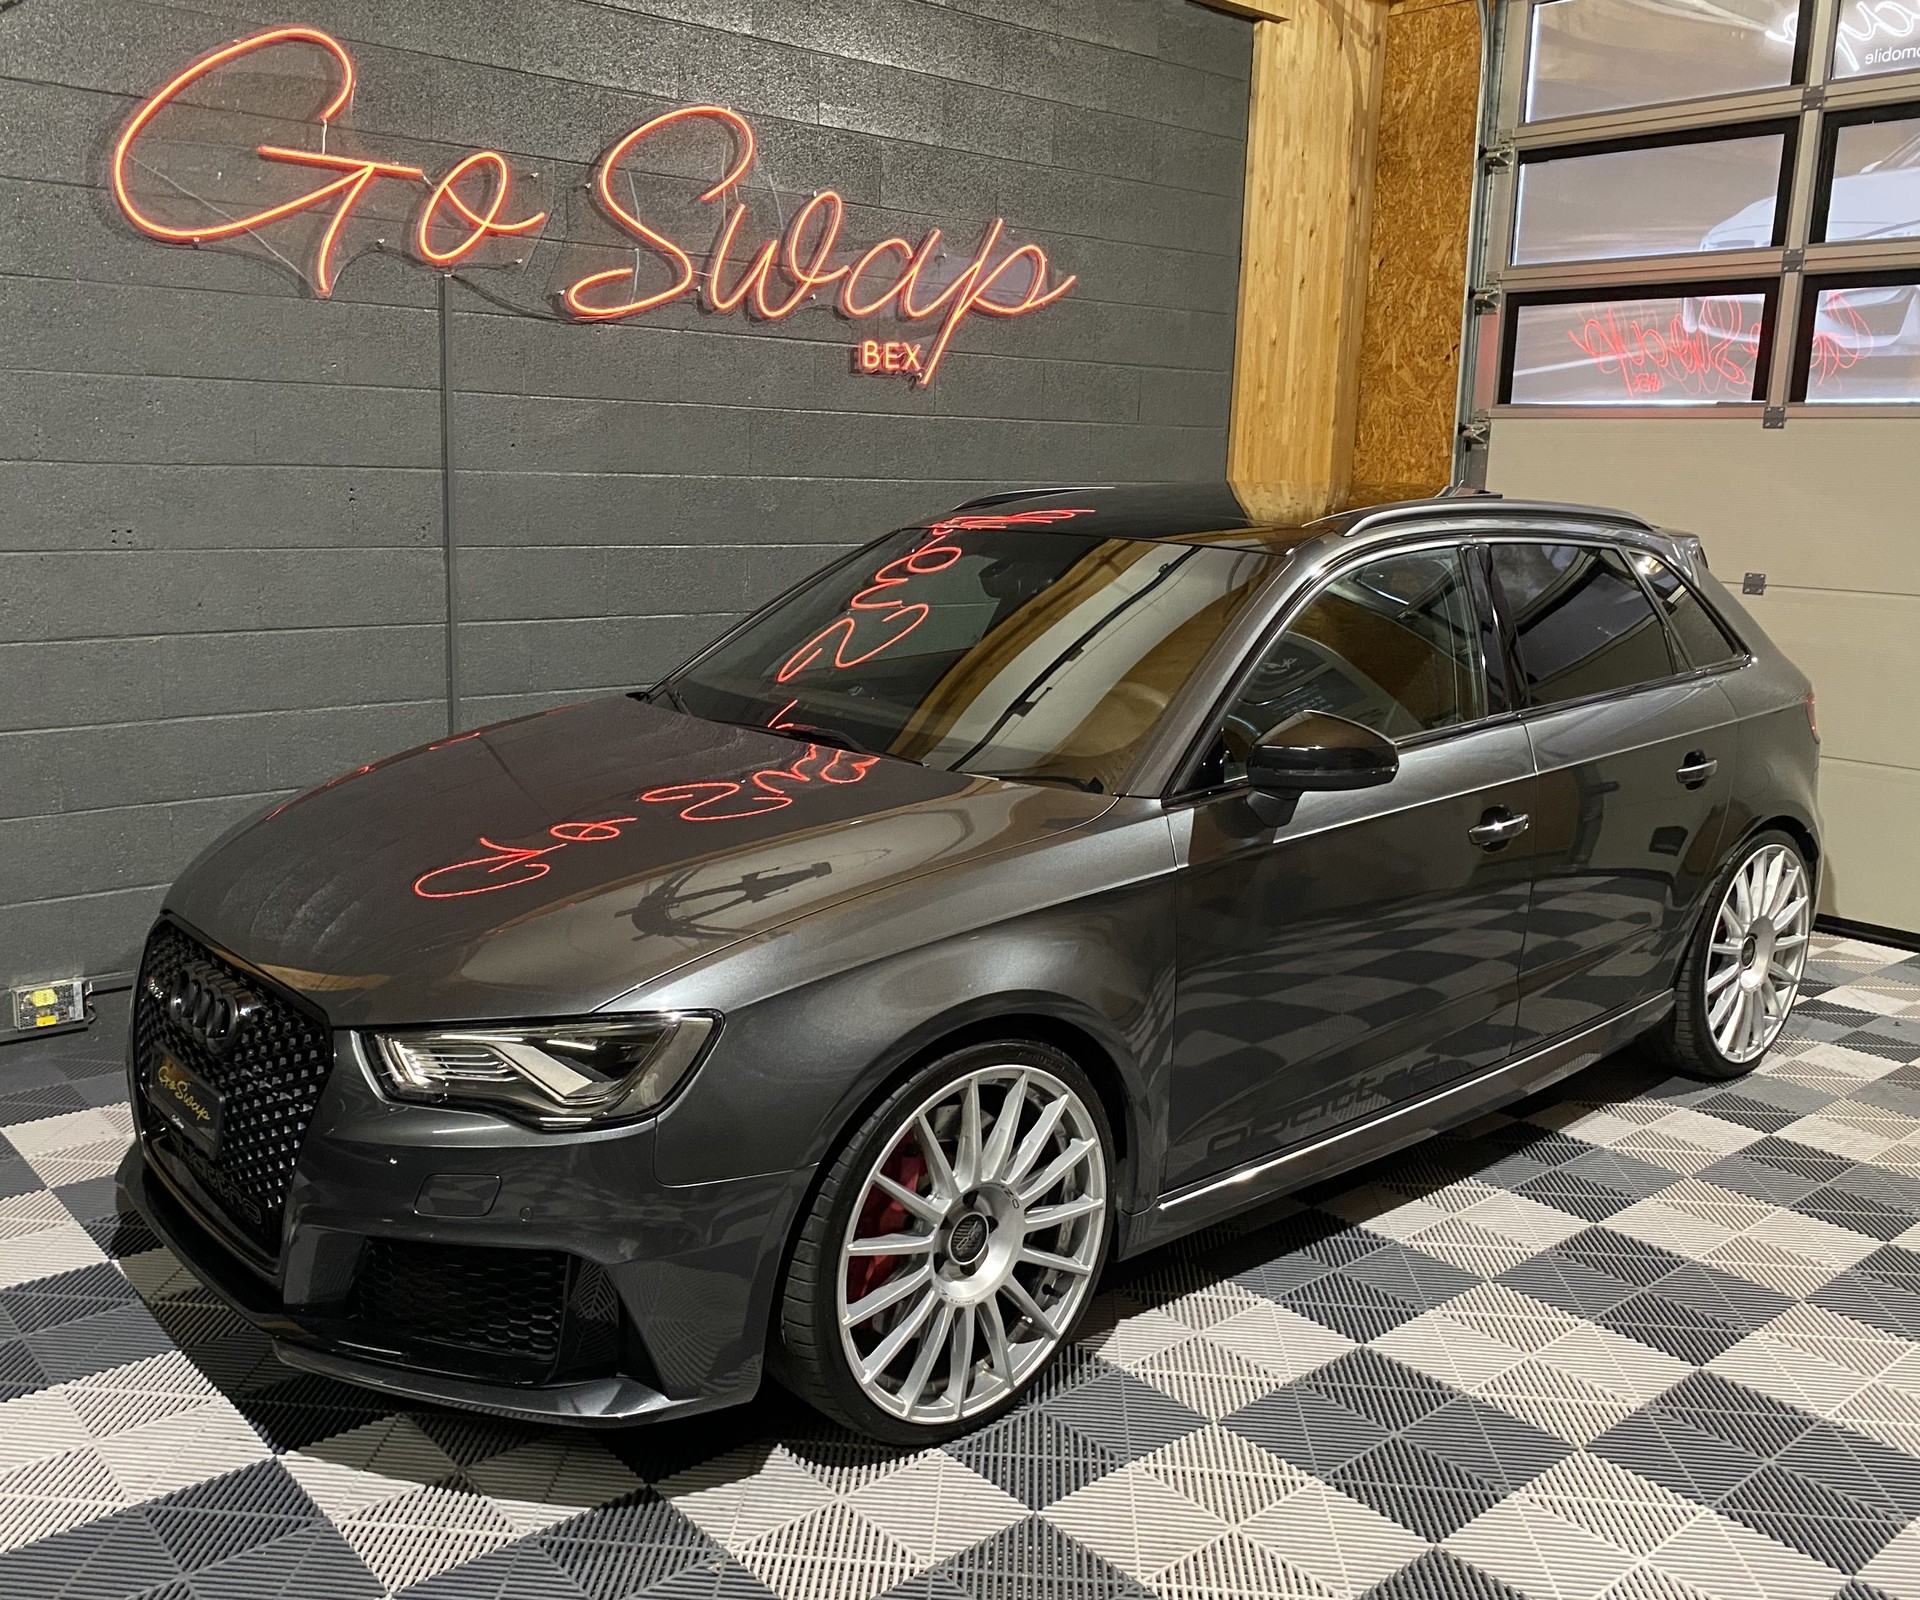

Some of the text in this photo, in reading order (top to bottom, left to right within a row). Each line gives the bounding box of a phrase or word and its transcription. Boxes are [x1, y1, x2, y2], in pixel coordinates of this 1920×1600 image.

[114, 26, 1077, 386] Go Swap
[859, 338, 921, 372] BEX
